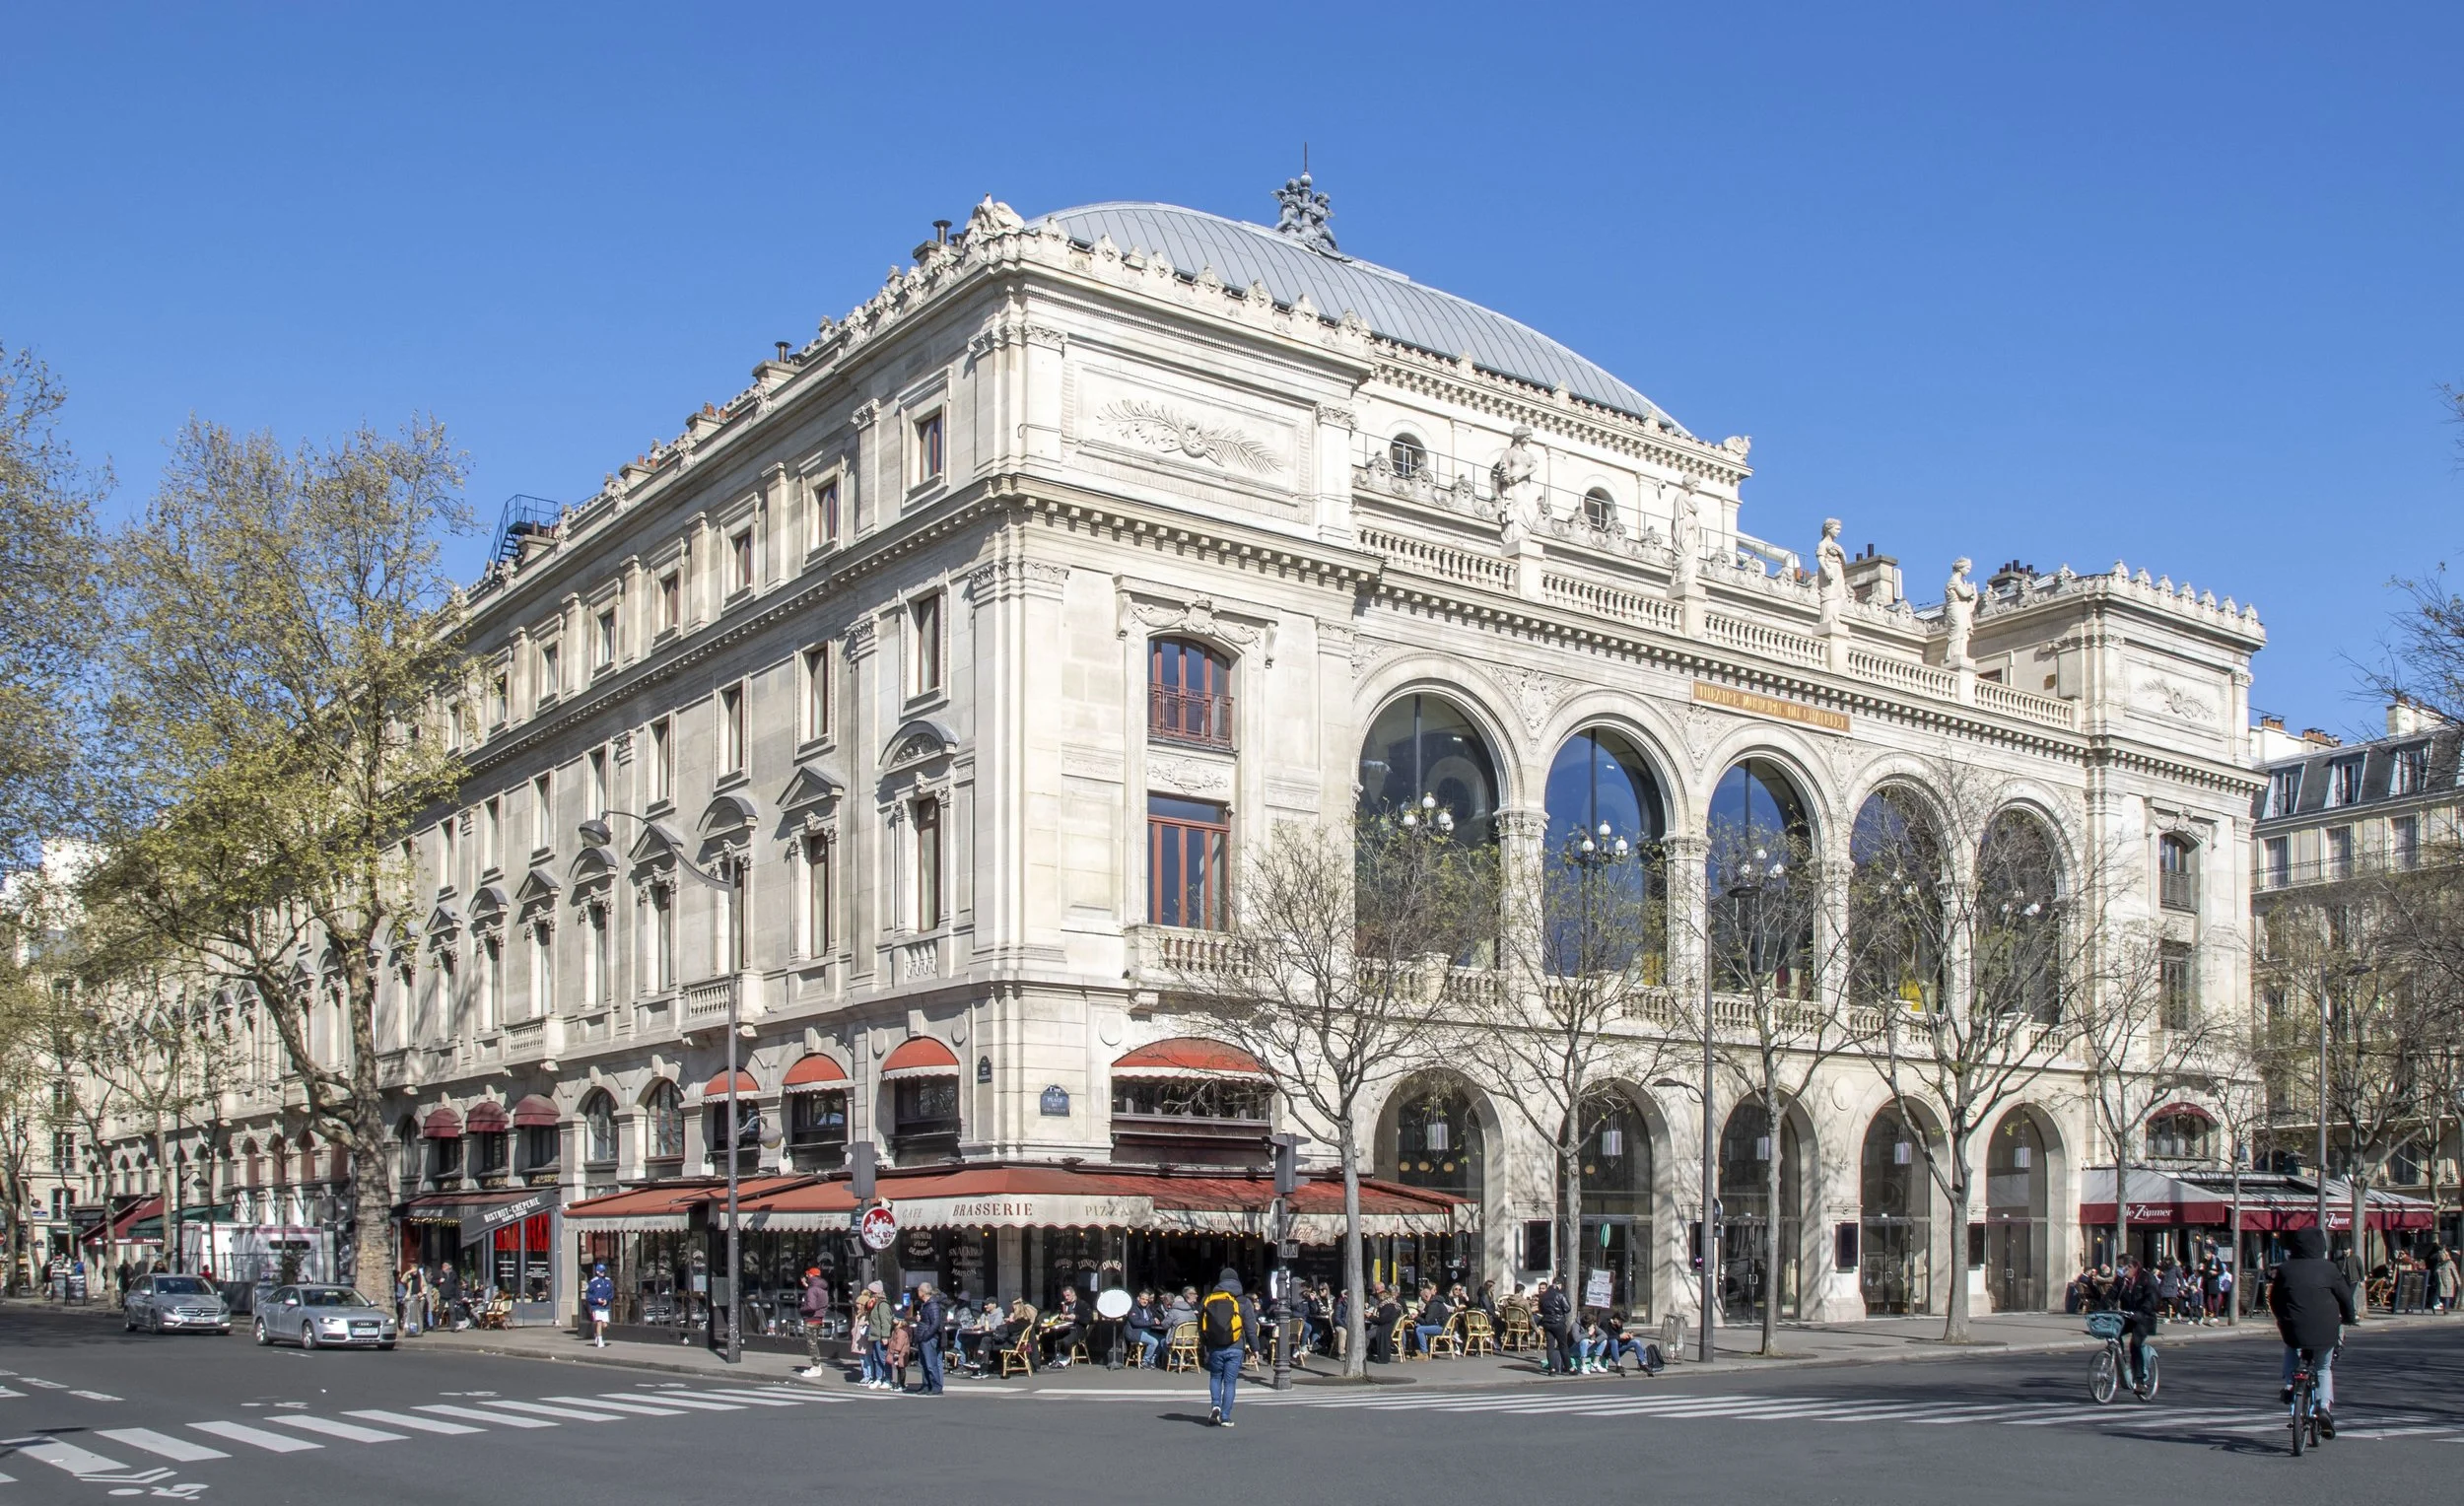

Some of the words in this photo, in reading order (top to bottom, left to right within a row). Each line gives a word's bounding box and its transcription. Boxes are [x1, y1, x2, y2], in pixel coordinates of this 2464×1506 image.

[952, 1202, 1033, 1217] BRASSERIE
[1085, 1205, 1129, 1217] PIZZA
[2134, 1204, 2173, 1221] Zimmer
[1077, 1259, 1099, 1270] LUNCH
[1101, 1260, 1123, 1272] DINNER
